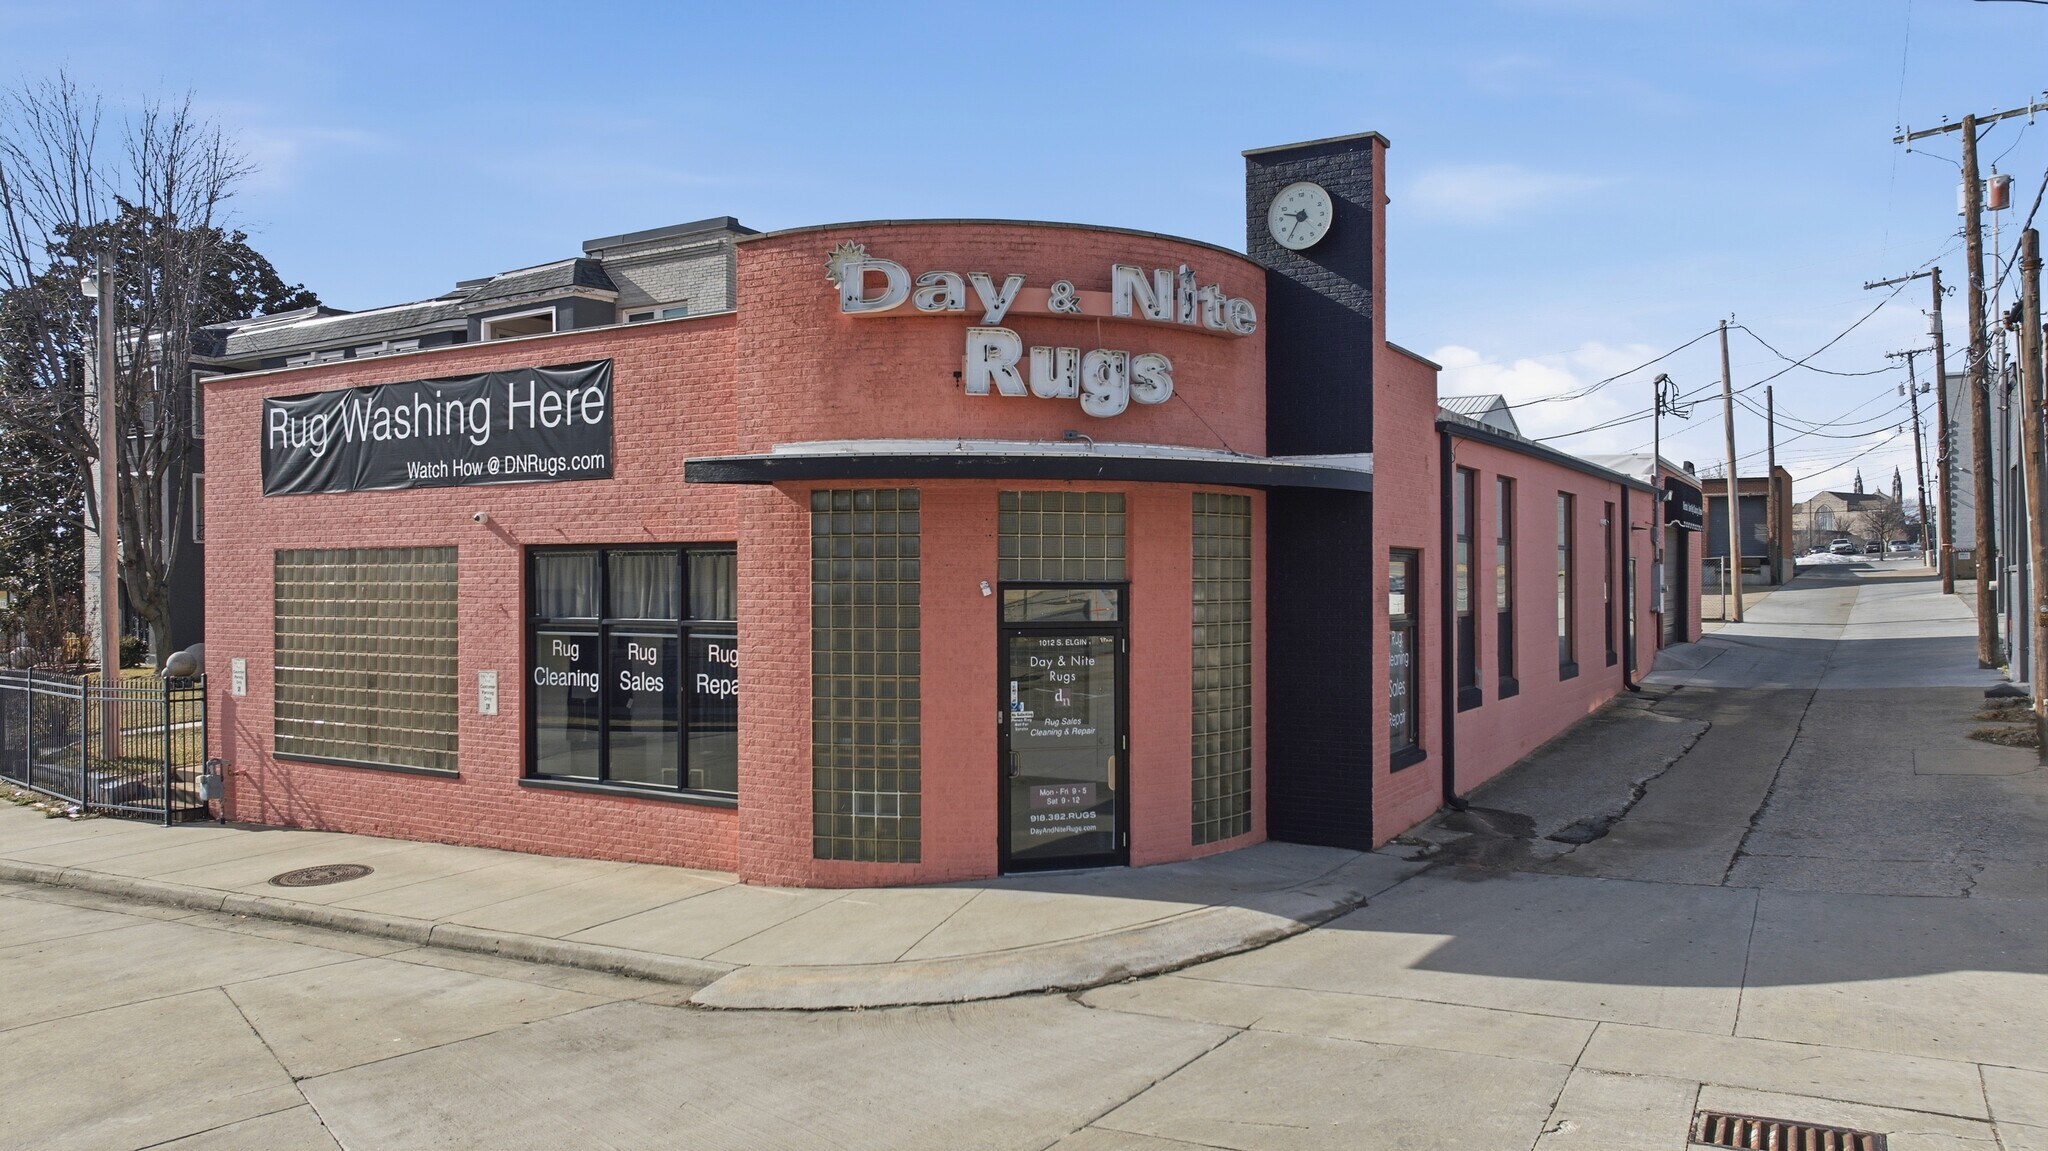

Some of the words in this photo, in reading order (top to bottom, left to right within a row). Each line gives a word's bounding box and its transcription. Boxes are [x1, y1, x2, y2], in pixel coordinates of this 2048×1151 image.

[839, 258, 1027, 326] Day
[1047, 279, 1083, 314] &
[1111, 263, 1258, 337] Nite
[964, 326, 1174, 418] Rugs
[269, 406, 329, 458] Rug
[339, 390, 491, 446] Washing
[508, 380, 606, 430] Here
[407, 460, 449, 480] Watch
[452, 458, 484, 477] How
[487, 456, 500, 474] @
[504, 452, 606, 474] DNRugs.com
[552, 639, 580, 661] Rug
[1039, 639, 1055, 647] 1012
[1056, 638, 1064, 646] S.
[1065, 638, 1087, 646] ELGIN
[1391, 630, 1403, 648] Rug
[628, 643, 657, 666] Rug
[708, 644, 738, 668] Rug
[1030, 656, 1053, 670] Day
[1057, 655, 1066, 667] &
[1071, 655, 1095, 666] Nite
[1389, 651, 1409, 668] leaning
[534, 666, 599, 693] Cleaning
[619, 670, 664, 692] Sales
[696, 673, 738, 699] Repa
[1050, 670, 1076, 684] Rugs
[1030, 728, 1063, 738] Cleaning
[1063, 727, 1070, 736] &
[1071, 727, 1096, 736] Repair
[1044, 717, 1060, 727] Rug
[1061, 717, 1082, 726] Sales
[1039, 788, 1055, 796] Mon
[1060, 787, 1069, 795] Fri
[1071, 787, 1077, 795] 9
[1082, 786, 1087, 794] 5
[1046, 797, 1059, 805] Sat
[1072, 796, 1080, 804] 12
